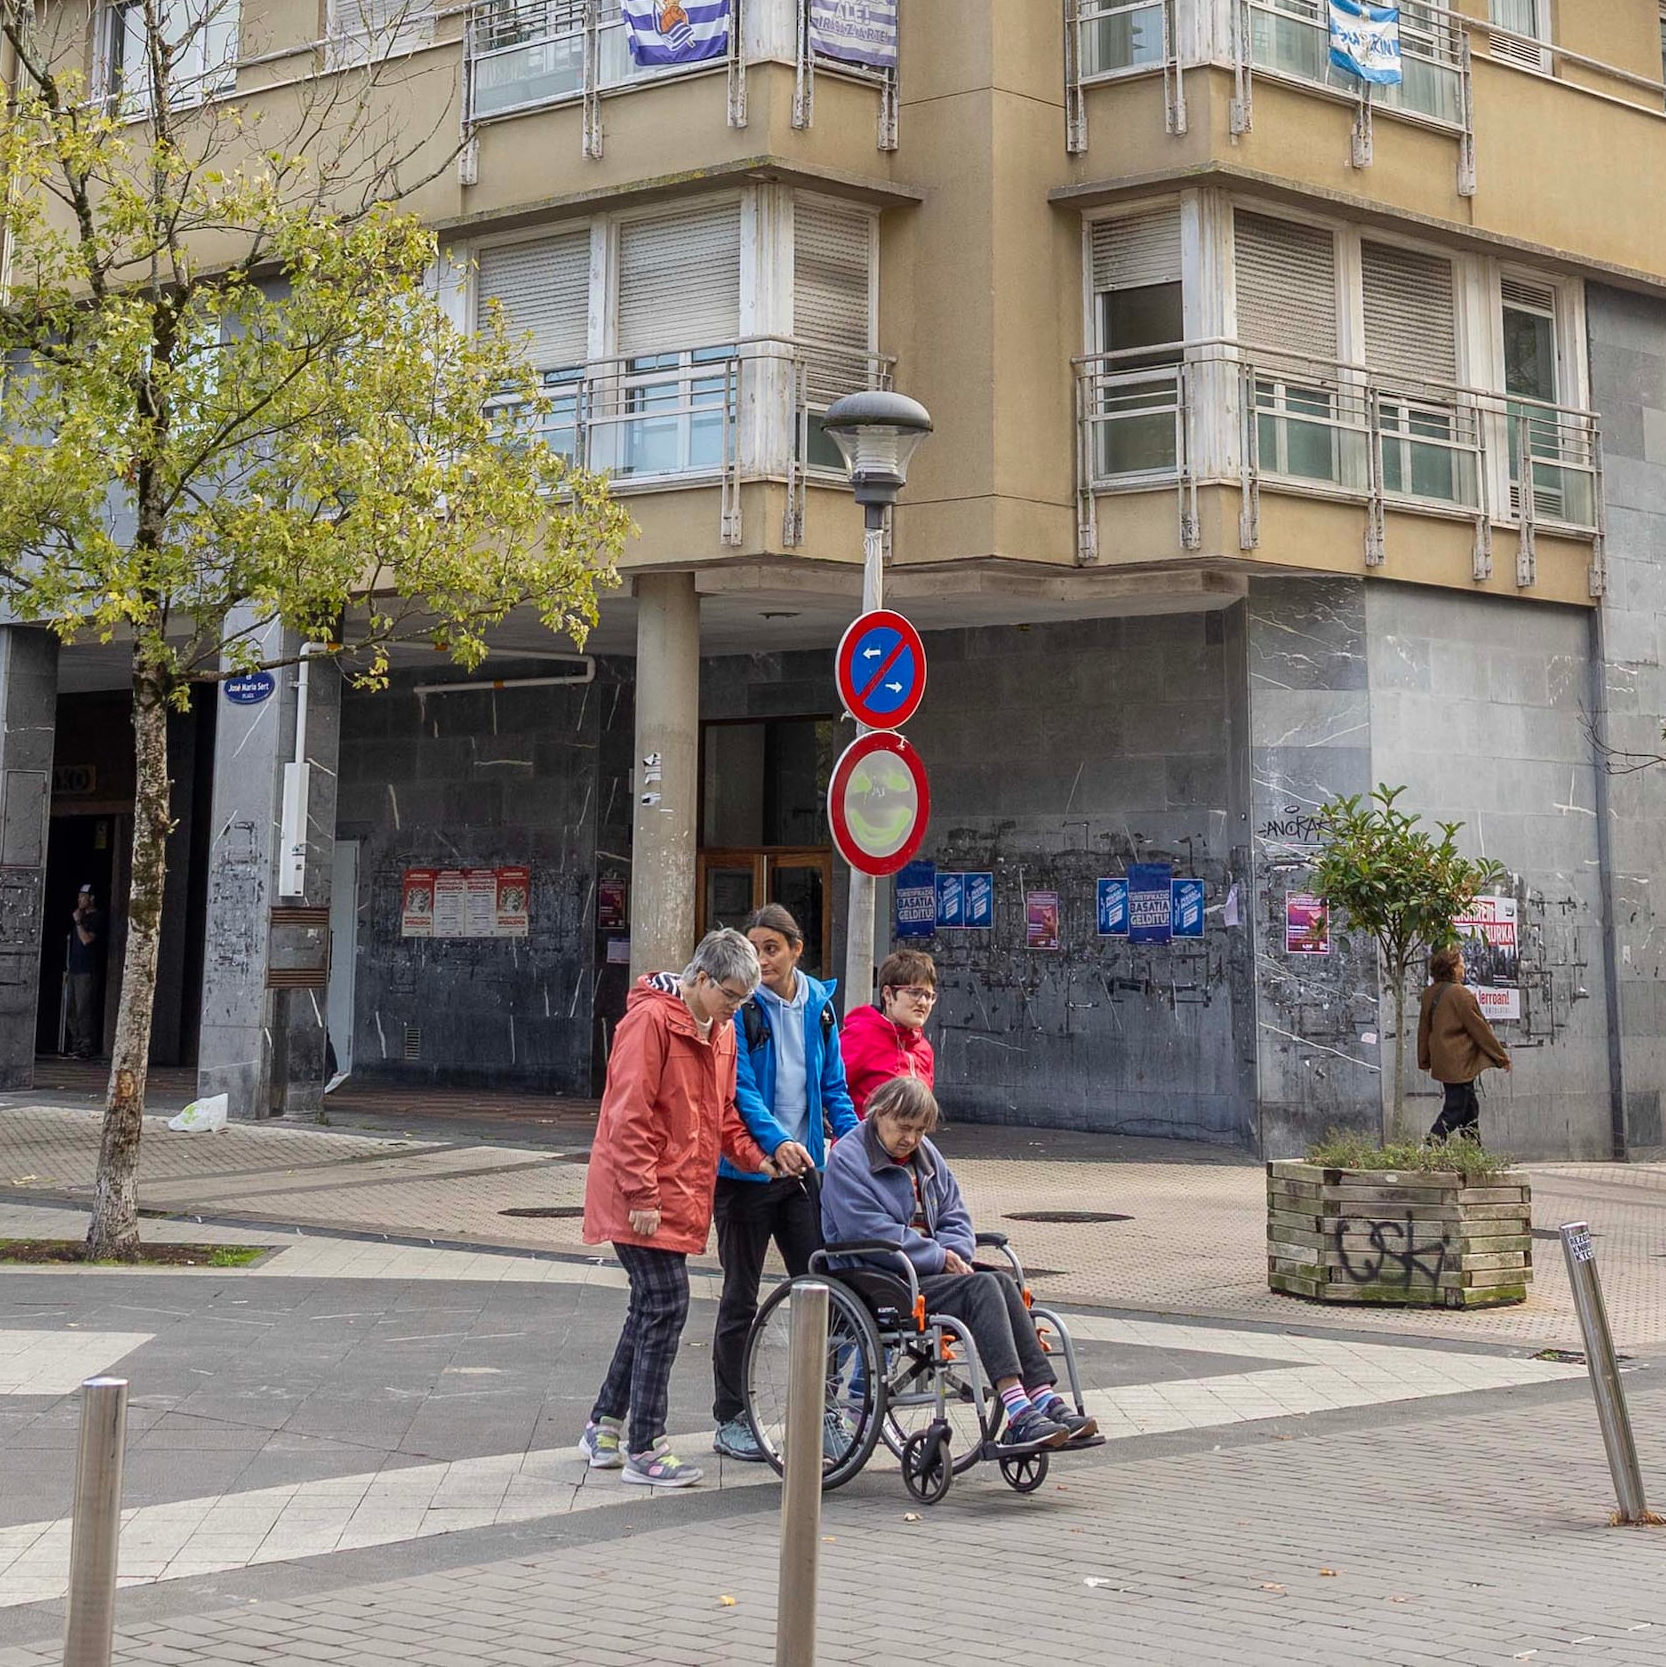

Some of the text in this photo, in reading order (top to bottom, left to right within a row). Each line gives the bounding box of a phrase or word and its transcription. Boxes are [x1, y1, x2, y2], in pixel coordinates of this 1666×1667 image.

[258, 682, 269, 690] Sert
[897, 896, 935, 910] BASATIA
[1130, 900, 1170, 914] BASATIA
[1130, 913, 1170, 926] GELDITU!
